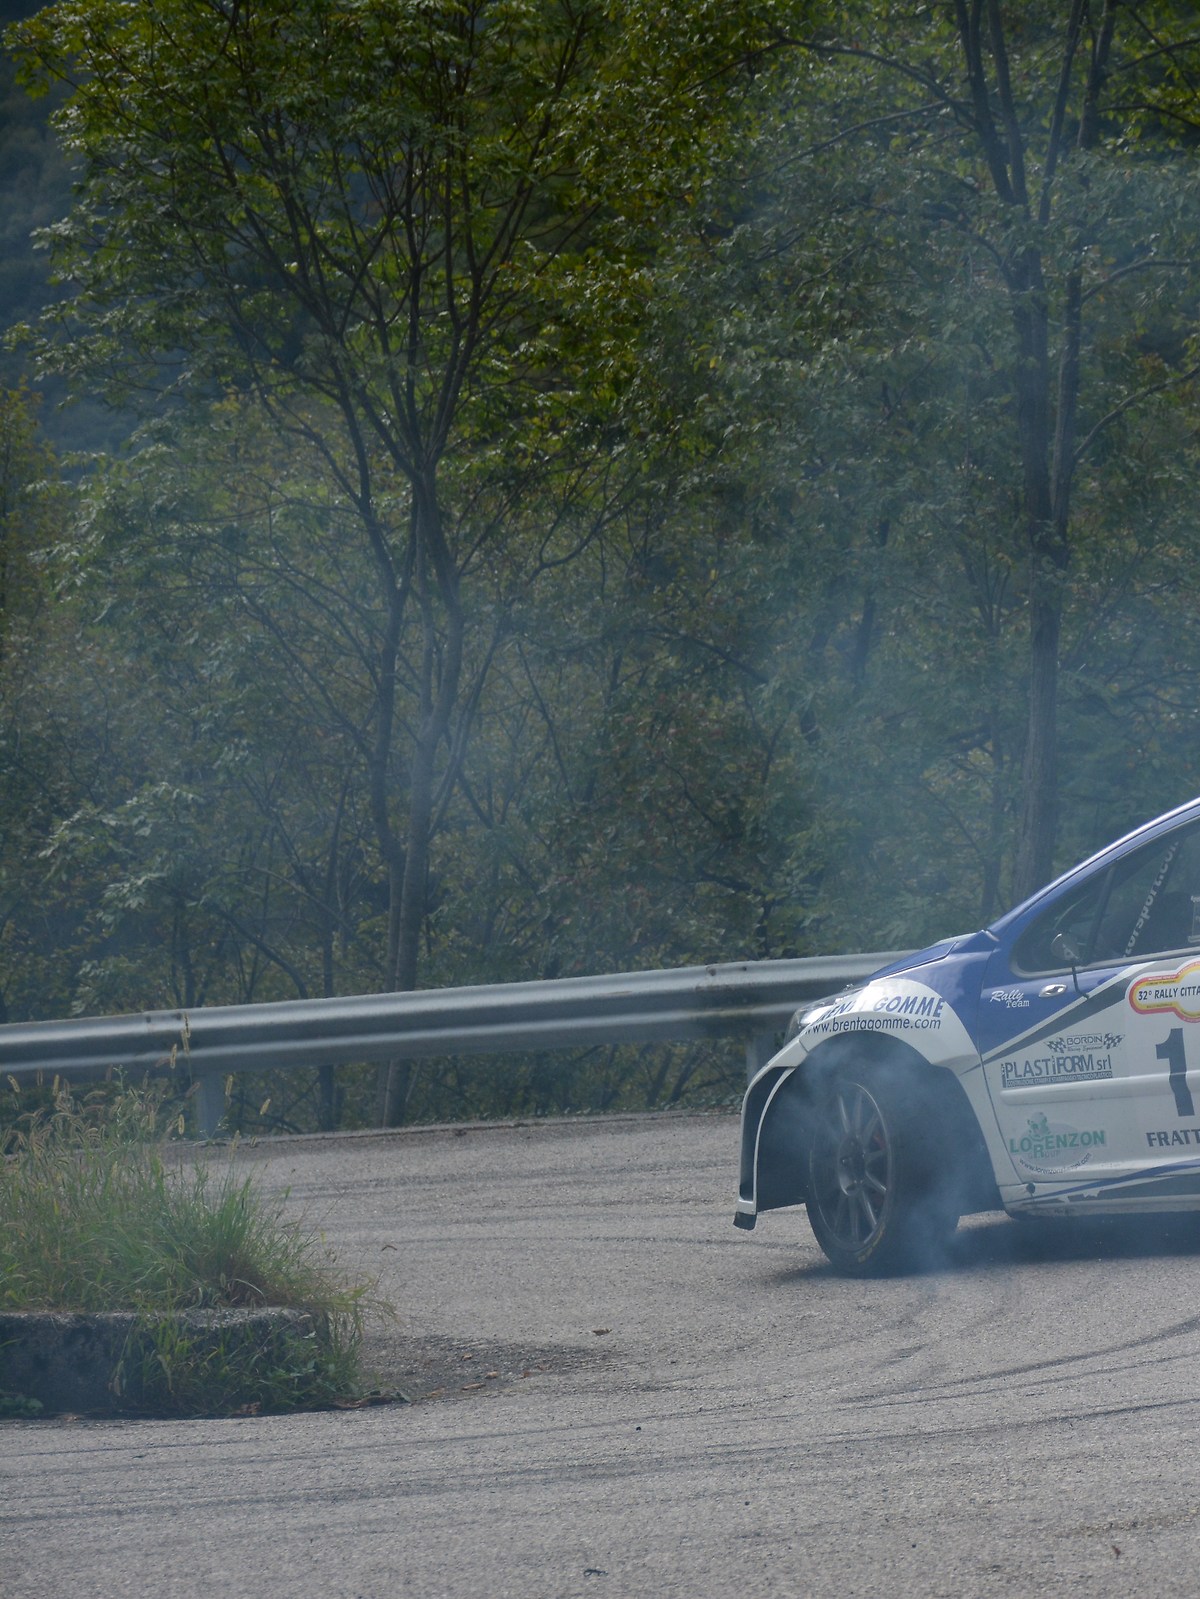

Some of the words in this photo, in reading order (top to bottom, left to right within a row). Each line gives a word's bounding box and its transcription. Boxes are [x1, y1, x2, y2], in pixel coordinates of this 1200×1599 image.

[990, 990, 1024, 1003] Rally
[1154, 988, 1179, 999] RALLY
[873, 996, 944, 1018] GOMME
[1006, 1000, 1030, 1009] Team
[1066, 1035, 1103, 1046] BORDIN
[1097, 1054, 1112, 1071] srl
[1010, 1130, 1106, 1158] LORENZON
